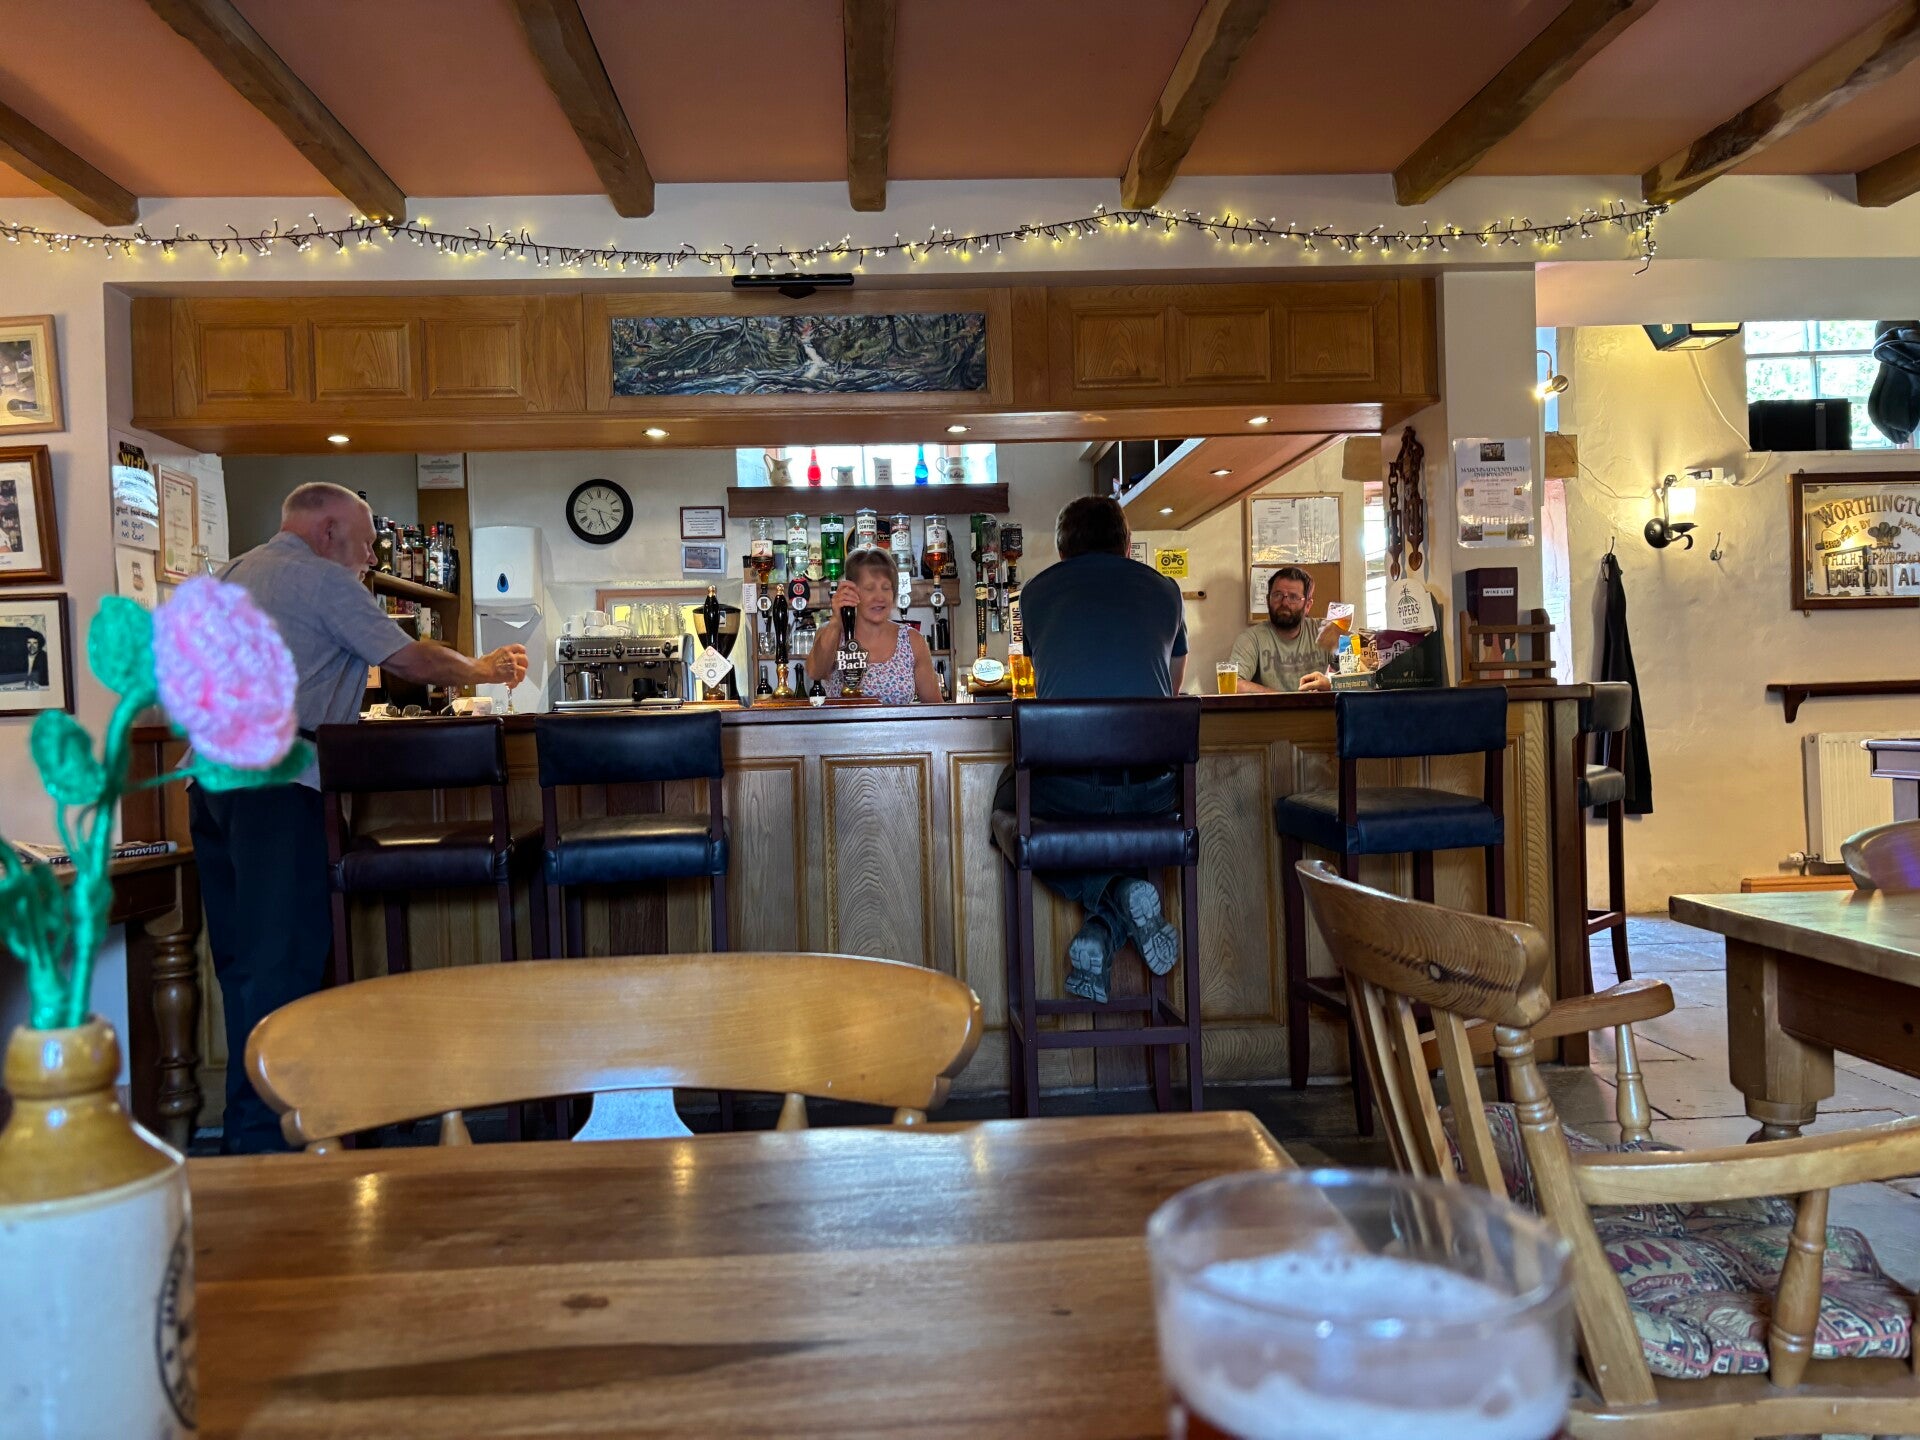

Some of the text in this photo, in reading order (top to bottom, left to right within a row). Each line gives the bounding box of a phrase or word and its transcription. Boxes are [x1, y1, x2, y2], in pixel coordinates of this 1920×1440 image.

[1859, 519, 1872, 530] BY
[1829, 568, 1920, 587] BURTON AL
[1397, 603, 1420, 618] PIPERS
[1013, 607, 1024, 643] CARLING
[836, 650, 869, 661] Butty
[837, 659, 867, 670] Bach
[124, 844, 166, 856] moving
